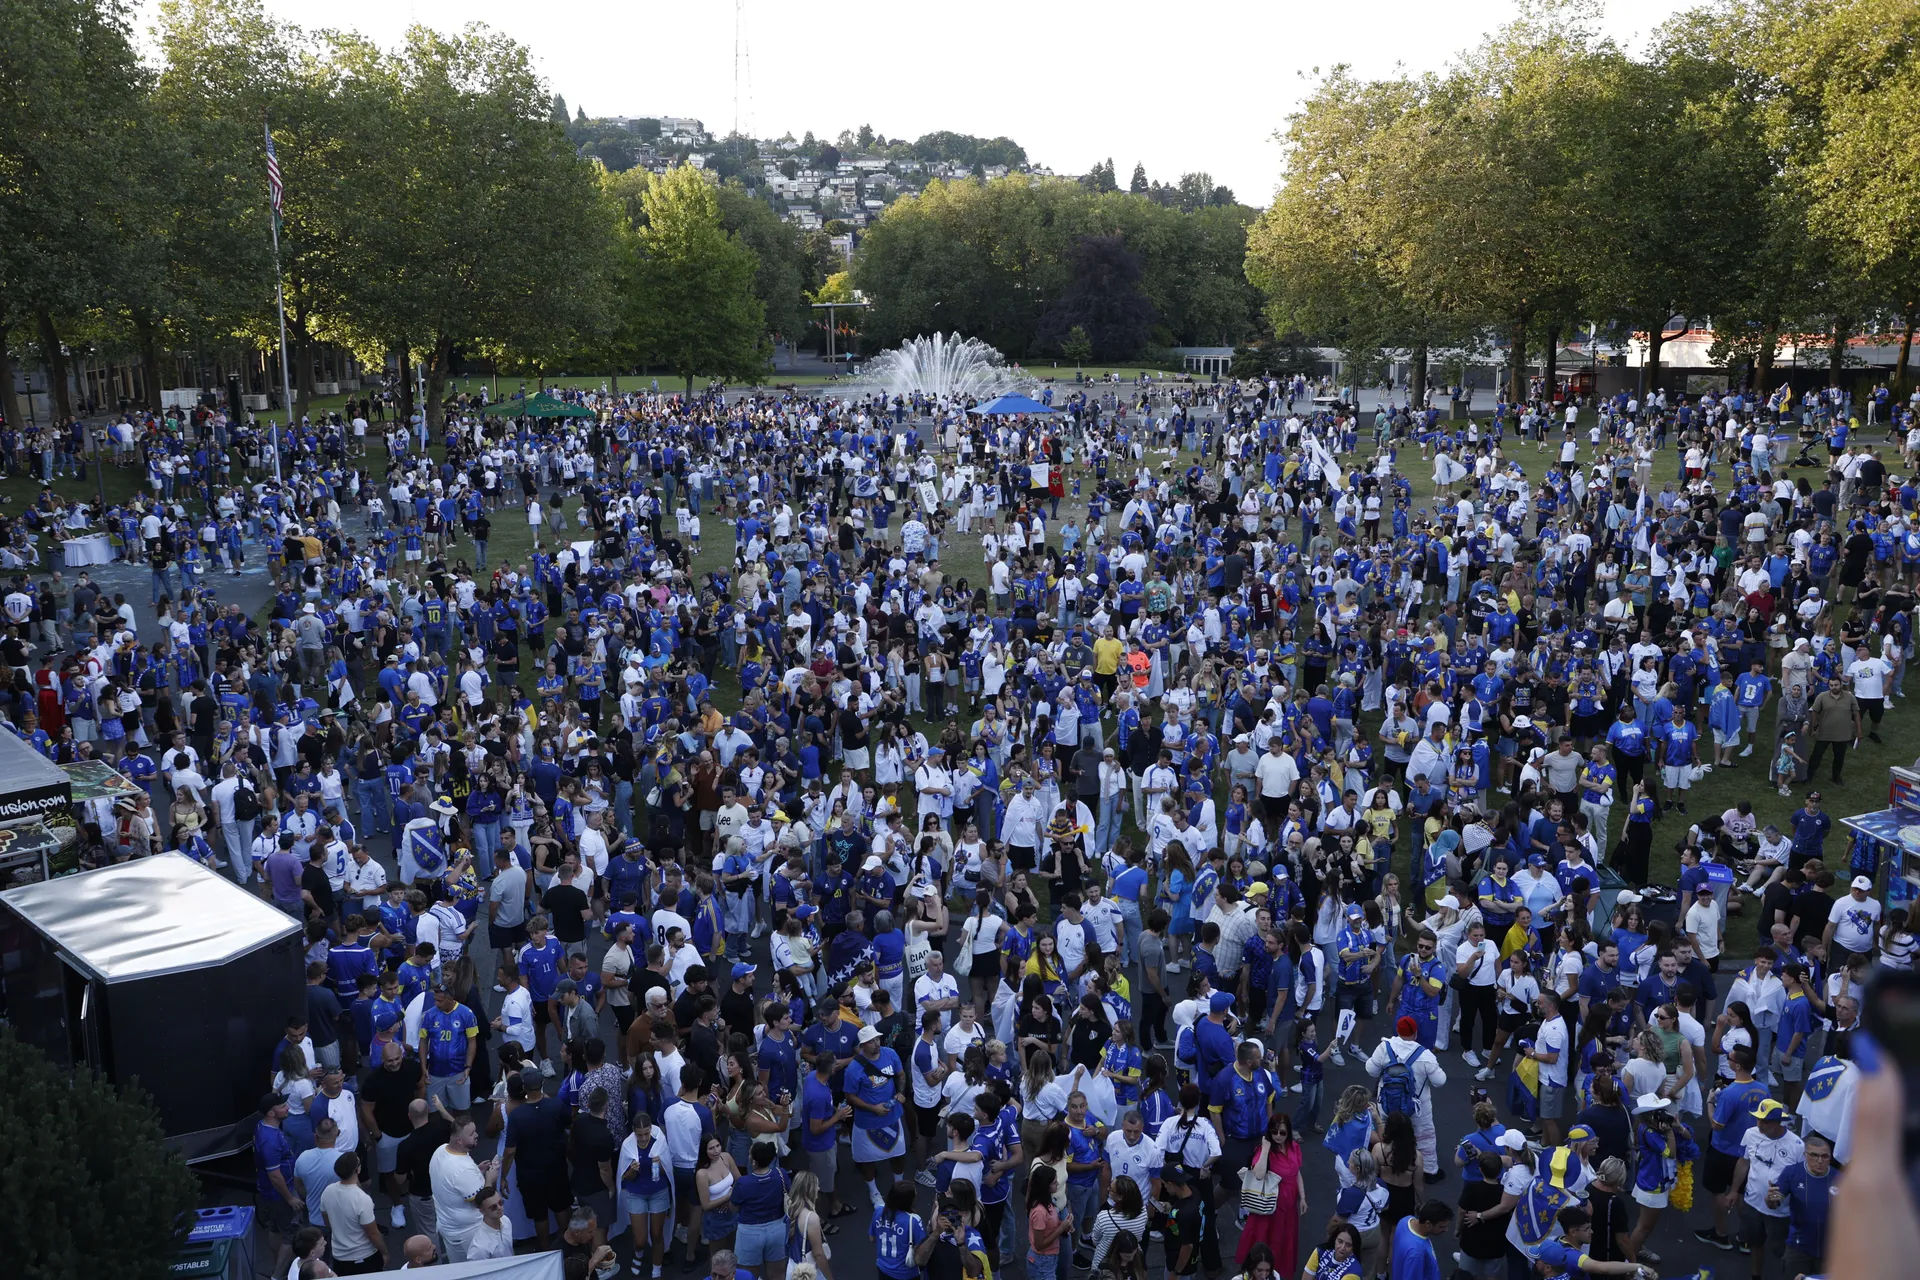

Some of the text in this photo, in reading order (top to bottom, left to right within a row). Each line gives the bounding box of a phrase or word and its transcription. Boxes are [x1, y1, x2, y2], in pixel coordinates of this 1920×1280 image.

[679, 517, 685, 525] 19
[1707, 564, 1710, 573] 1
[1014, 587, 1025, 600] 20
[11, 602, 21, 613] 11
[428, 610, 440, 623] 10
[223, 707, 236, 720] 19
[290, 709, 299, 721] 11
[654, 706, 661, 720] 7
[389, 778, 400, 794] 10
[453, 780, 470, 797] 20
[718, 815, 731, 825] Lee
[1155, 826, 1160, 838] 9
[336, 850, 346, 874] 5
[1565, 877, 1570, 885] 11
[396, 919, 402, 927] 11
[657, 925, 665, 945] 8
[1066, 938, 1070, 947] 7
[543, 963, 551, 972] 11
[938, 989, 942, 999] 1
[440, 1030, 451, 1041] 20
[1123, 1163, 1128, 1174] 9
[879, 1232, 897, 1258] 11
